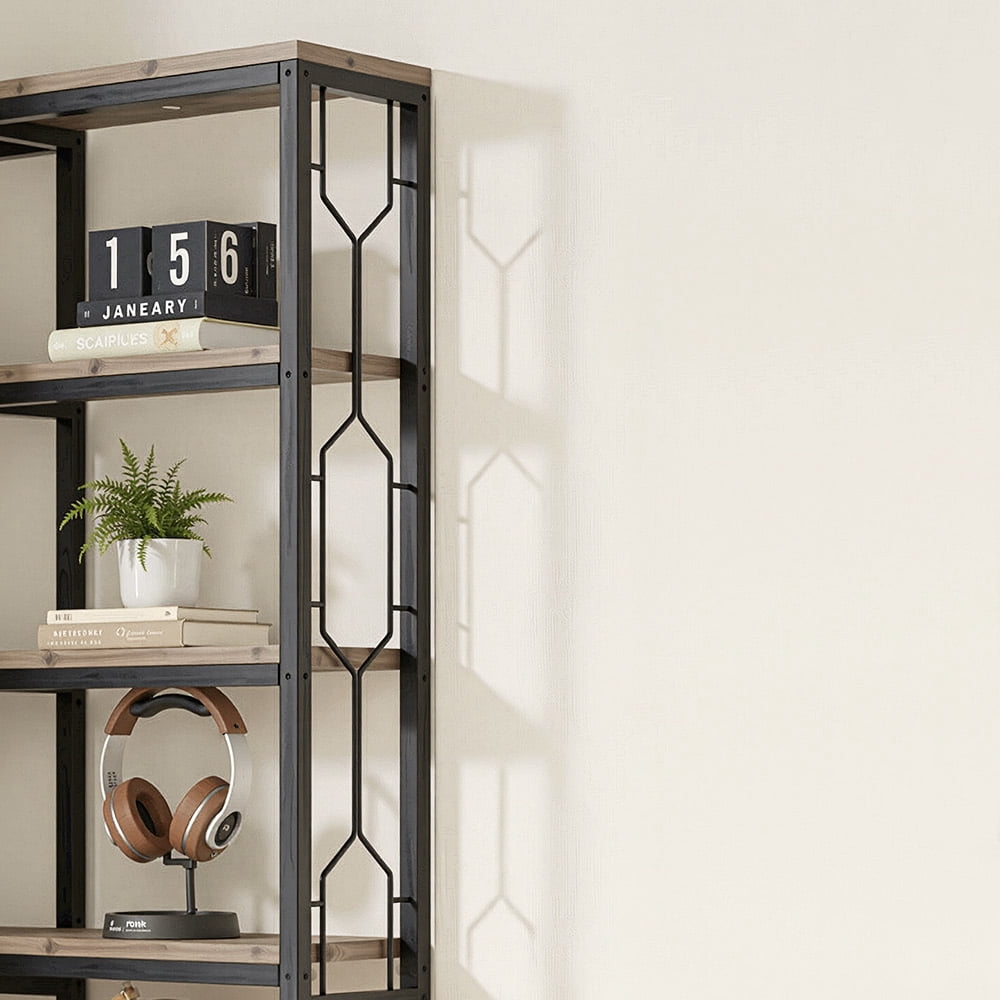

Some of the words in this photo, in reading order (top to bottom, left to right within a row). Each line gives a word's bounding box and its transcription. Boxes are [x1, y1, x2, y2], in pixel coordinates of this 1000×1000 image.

[106, 236, 118, 289] 1
[169, 231, 190, 286] 5
[220, 230, 238, 285] 6
[102, 298, 186, 320] JANEARY
